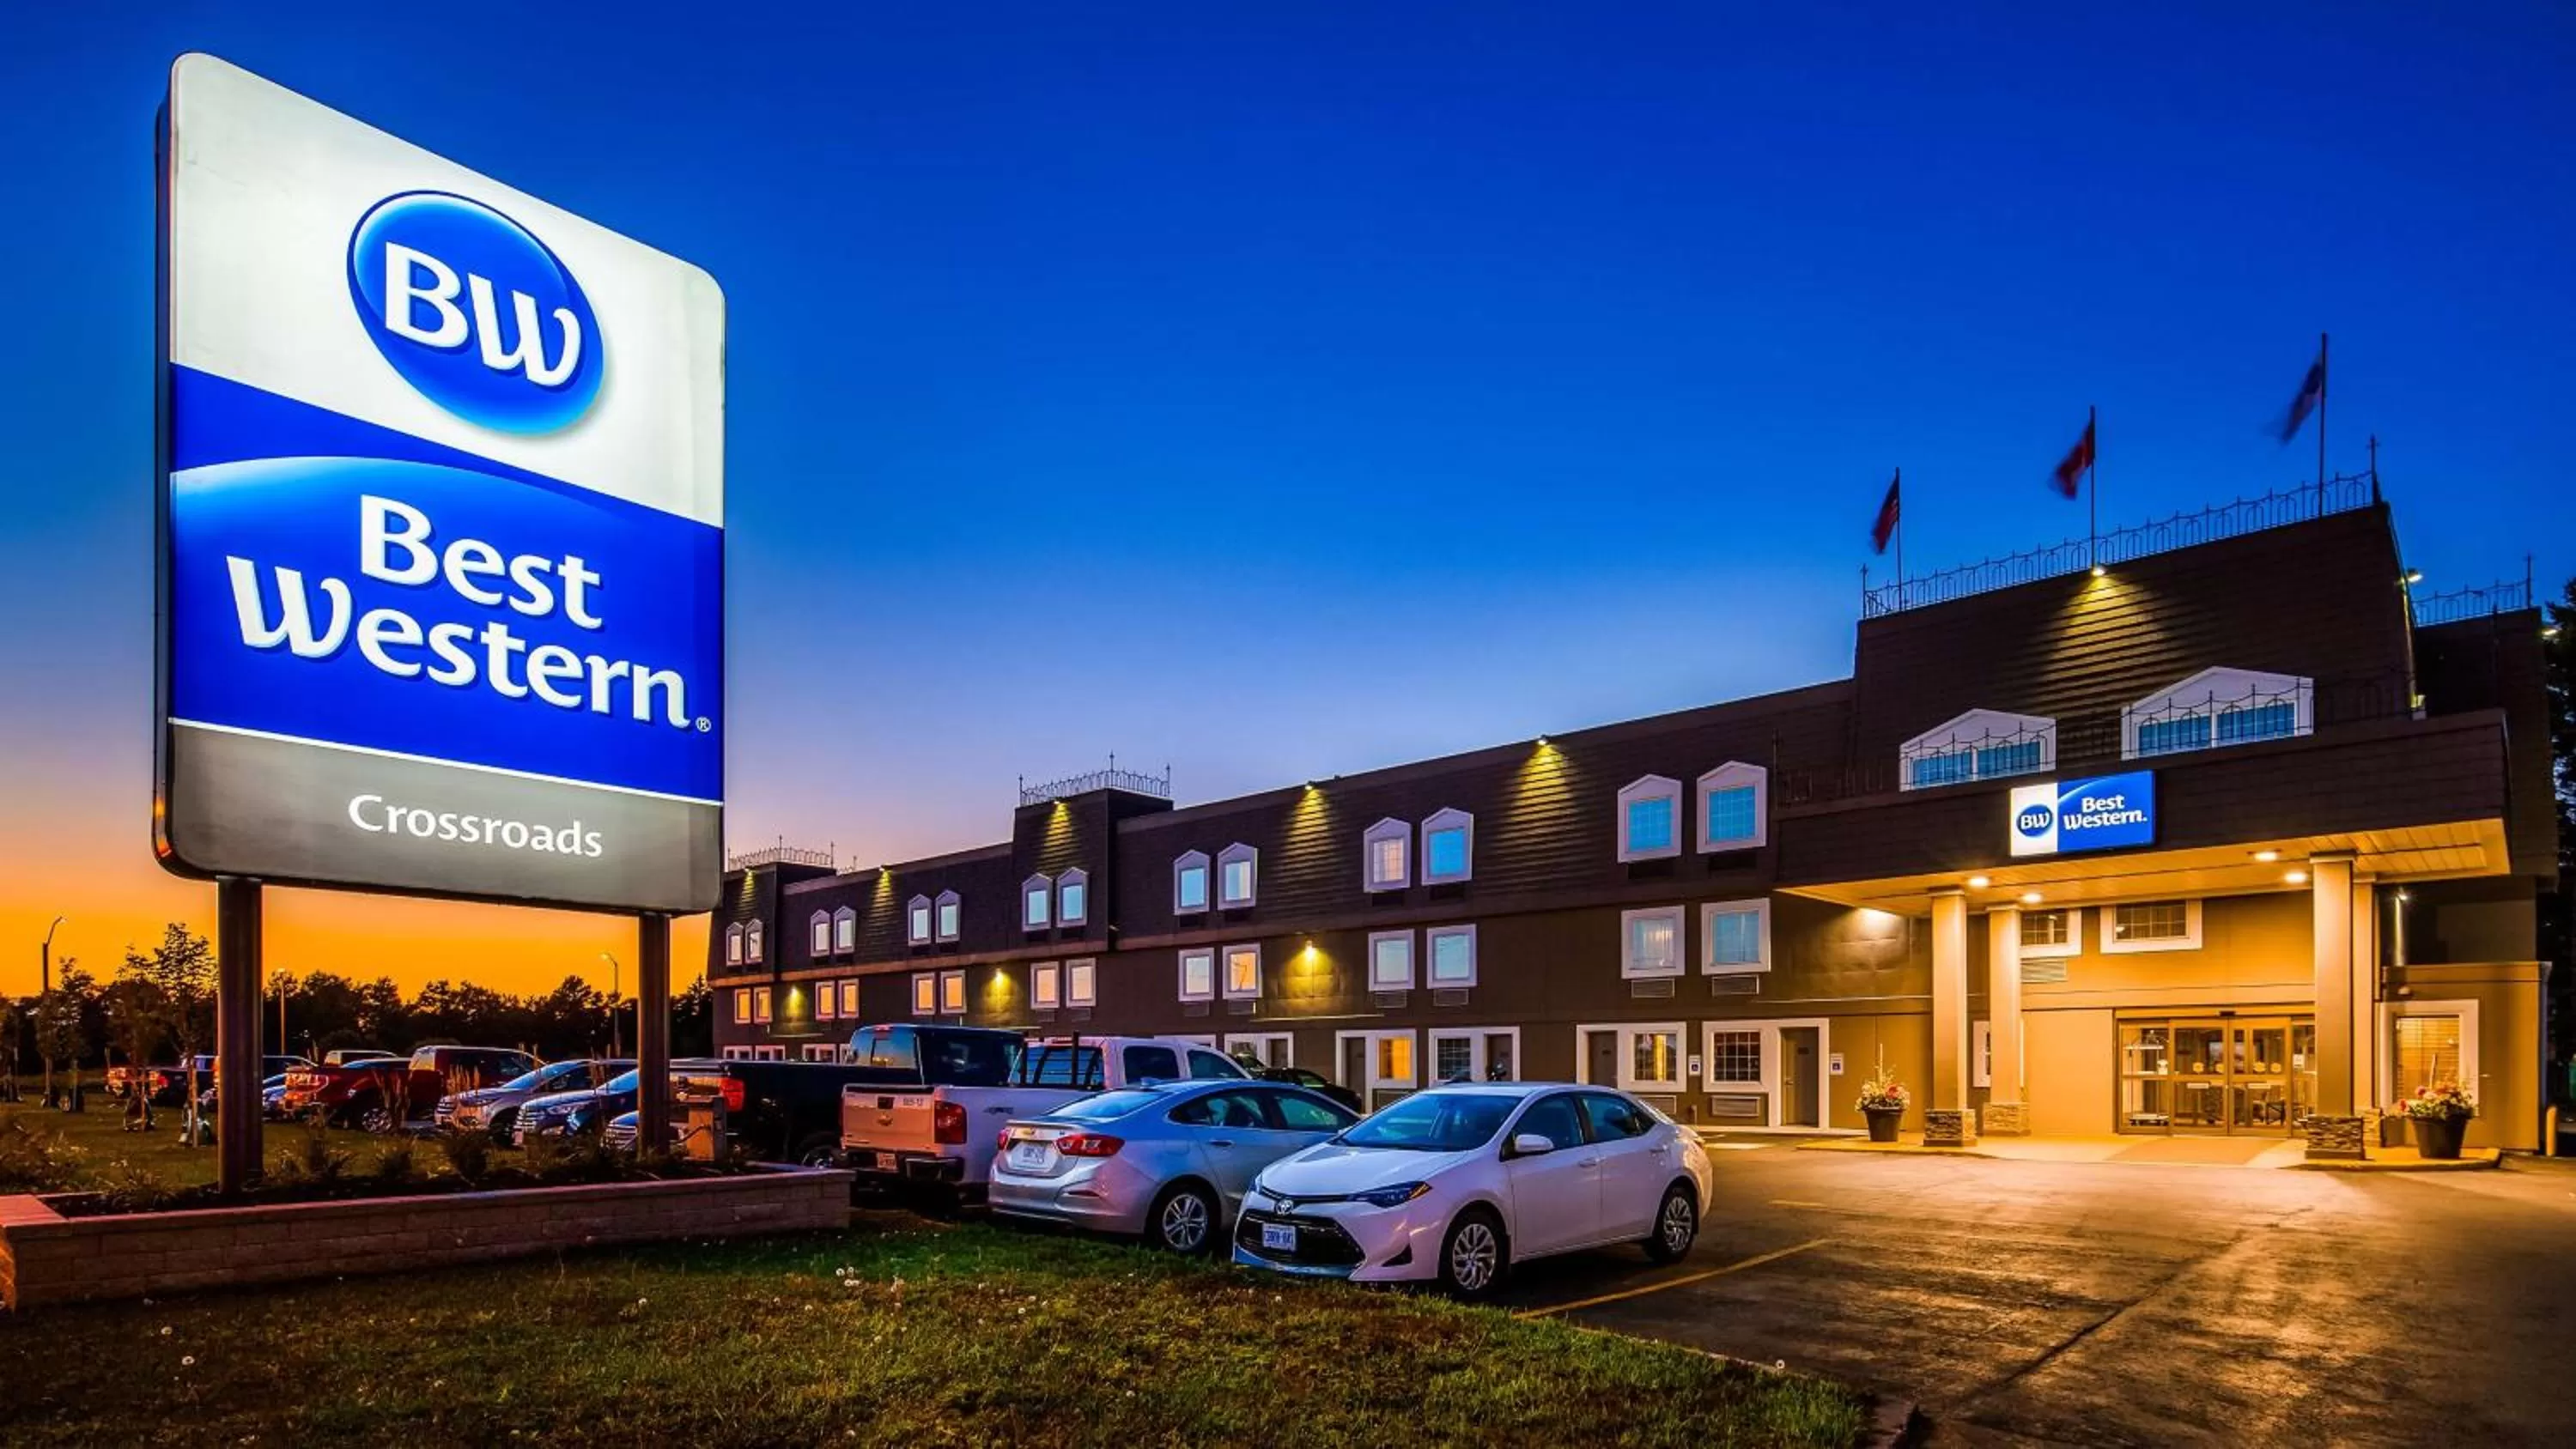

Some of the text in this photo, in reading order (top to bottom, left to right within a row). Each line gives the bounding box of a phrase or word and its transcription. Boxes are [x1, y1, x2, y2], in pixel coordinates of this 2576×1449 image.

[384, 242, 581, 386] BW
[360, 494, 603, 628] Best
[348, 793, 604, 858] Crossroads
[2020, 812, 2050, 830] BW
[2081, 795, 2125, 813] Best
